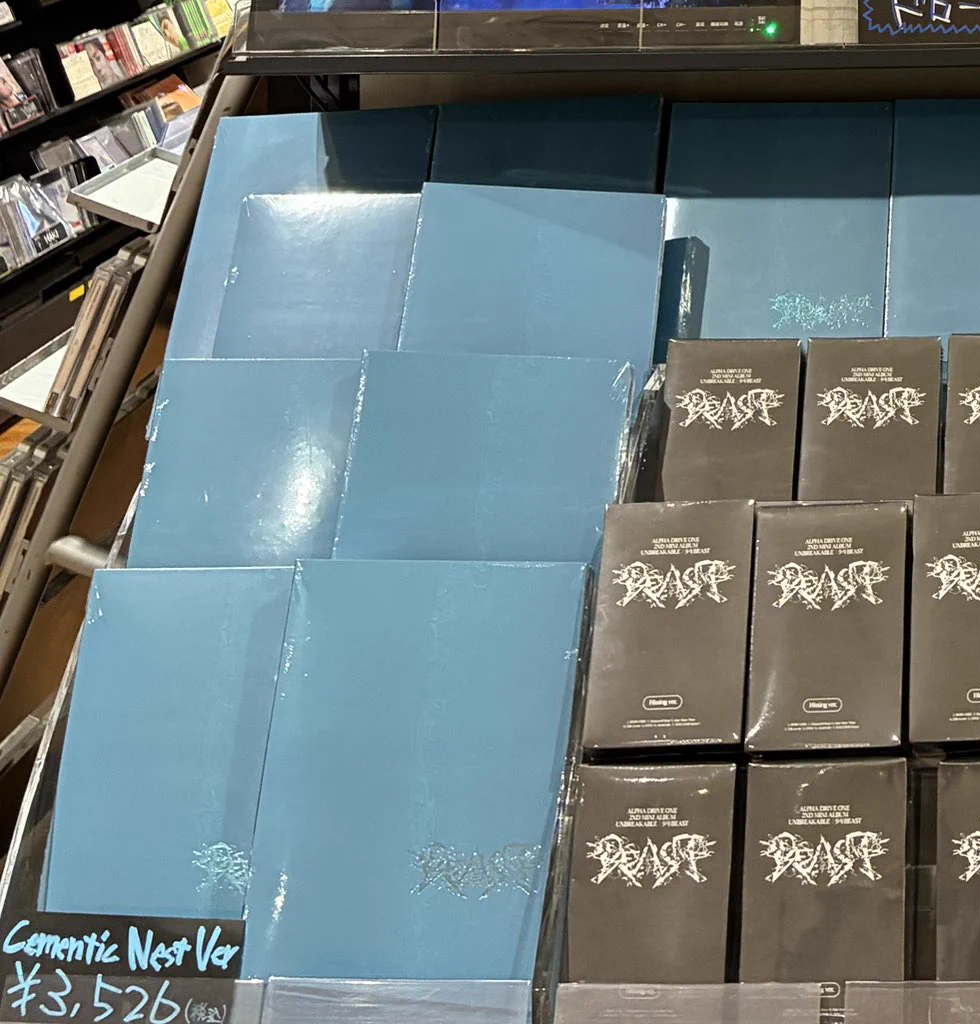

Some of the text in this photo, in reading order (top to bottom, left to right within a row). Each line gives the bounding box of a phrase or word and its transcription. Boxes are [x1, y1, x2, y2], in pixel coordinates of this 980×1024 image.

[3, 920, 240, 972] Cementic Nest Ver
[7, 961, 181, 1024] ¥3,526
